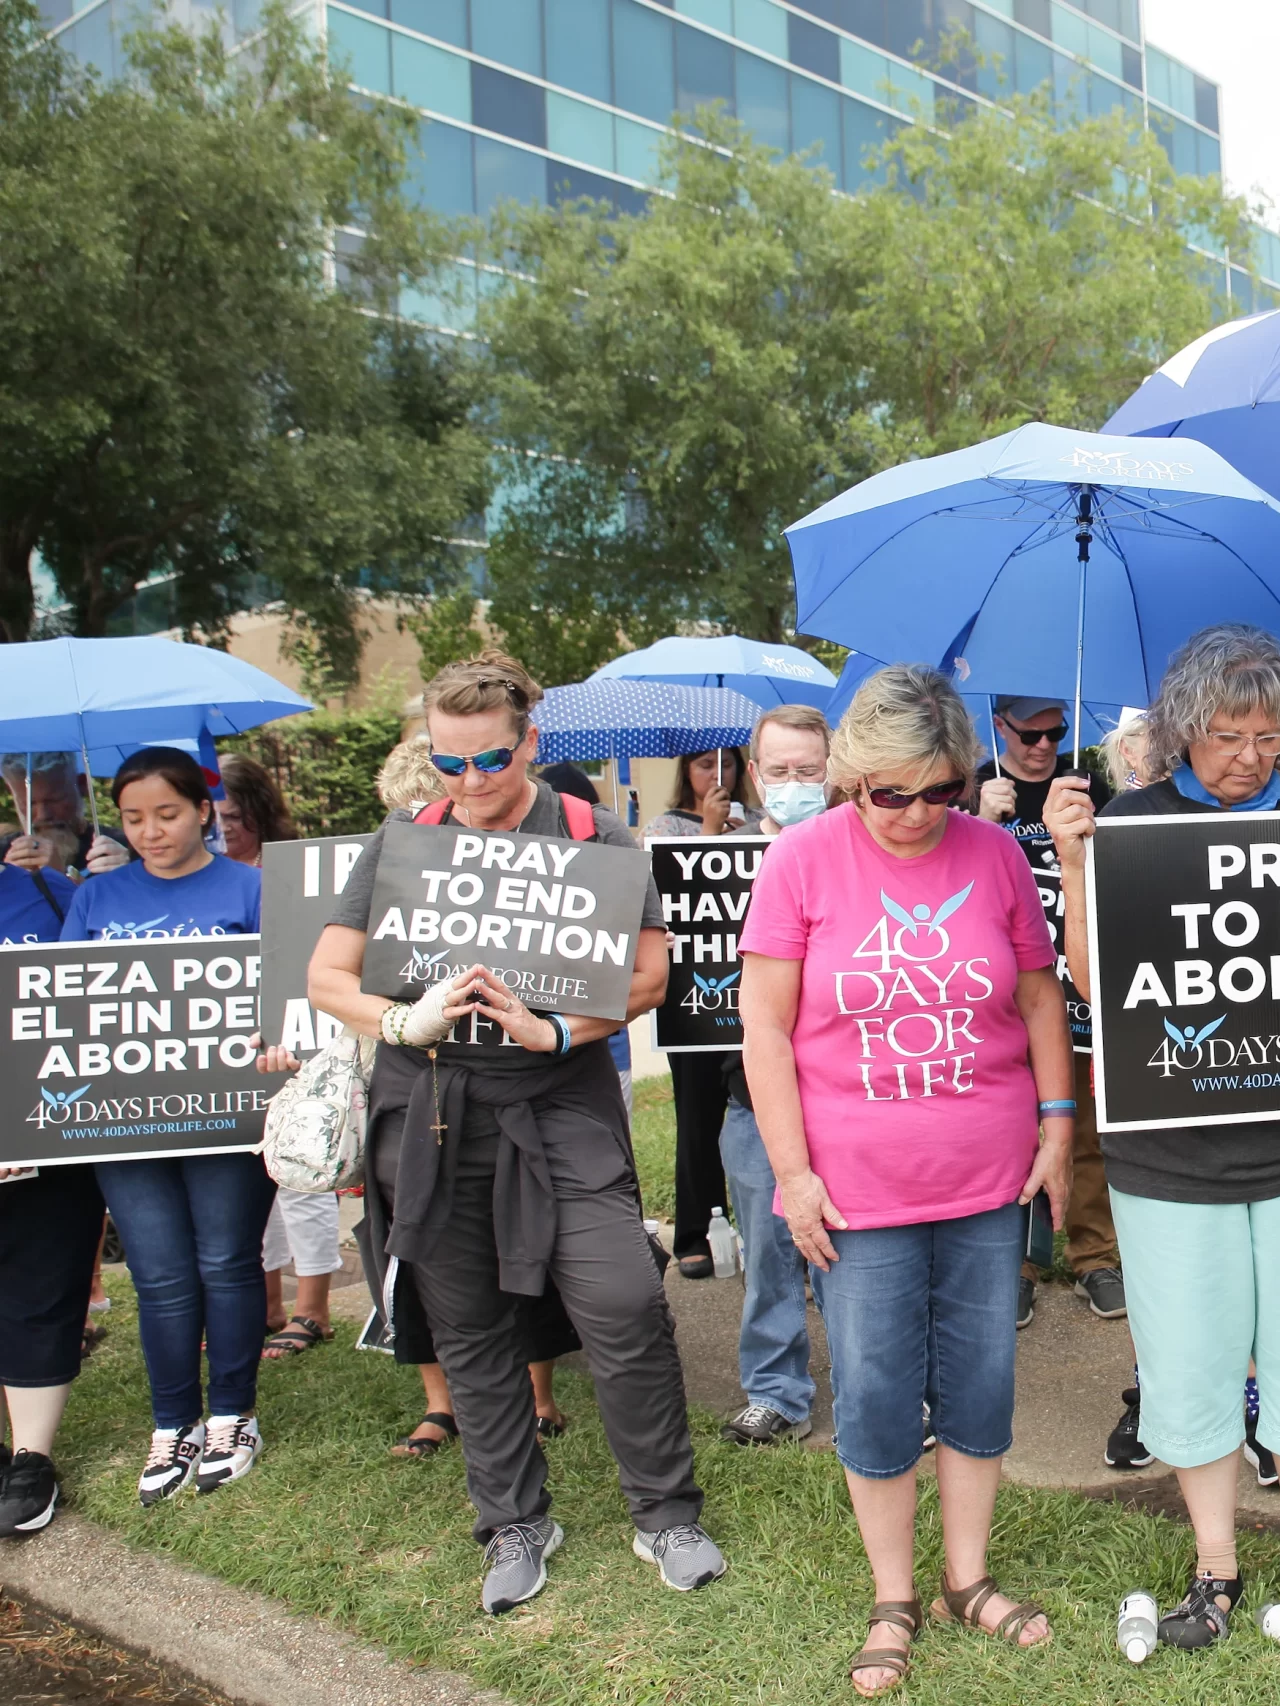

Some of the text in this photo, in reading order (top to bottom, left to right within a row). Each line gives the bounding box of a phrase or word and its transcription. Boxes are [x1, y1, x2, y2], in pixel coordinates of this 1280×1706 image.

[1114, 456, 1195, 475] DAYS
[451, 833, 581, 879] PRAY
[421, 869, 597, 920] TO END
[662, 891, 751, 922] HAV
[372, 906, 630, 967] ABORTION
[852, 914, 950, 974] 40
[1171, 900, 1261, 949] TO
[18, 960, 159, 1000] REZA
[398, 958, 433, 984] 40
[831, 957, 994, 1016] DAYS
[11, 1006, 74, 1041] EL
[88, 999, 172, 1036] FIN
[187, 994, 262, 1031] DE
[680, 984, 722, 1015] 40
[852, 1007, 985, 1059] FOR
[37, 1034, 258, 1080] ABORTO
[856, 1051, 976, 1101] LIFE
[1146, 1036, 1203, 1078] 40
[25, 1089, 268, 1130] 40 DAYS FOR LIFE
[61, 1118, 237, 1140] WWW.40DAYSFORLIFE.COM
